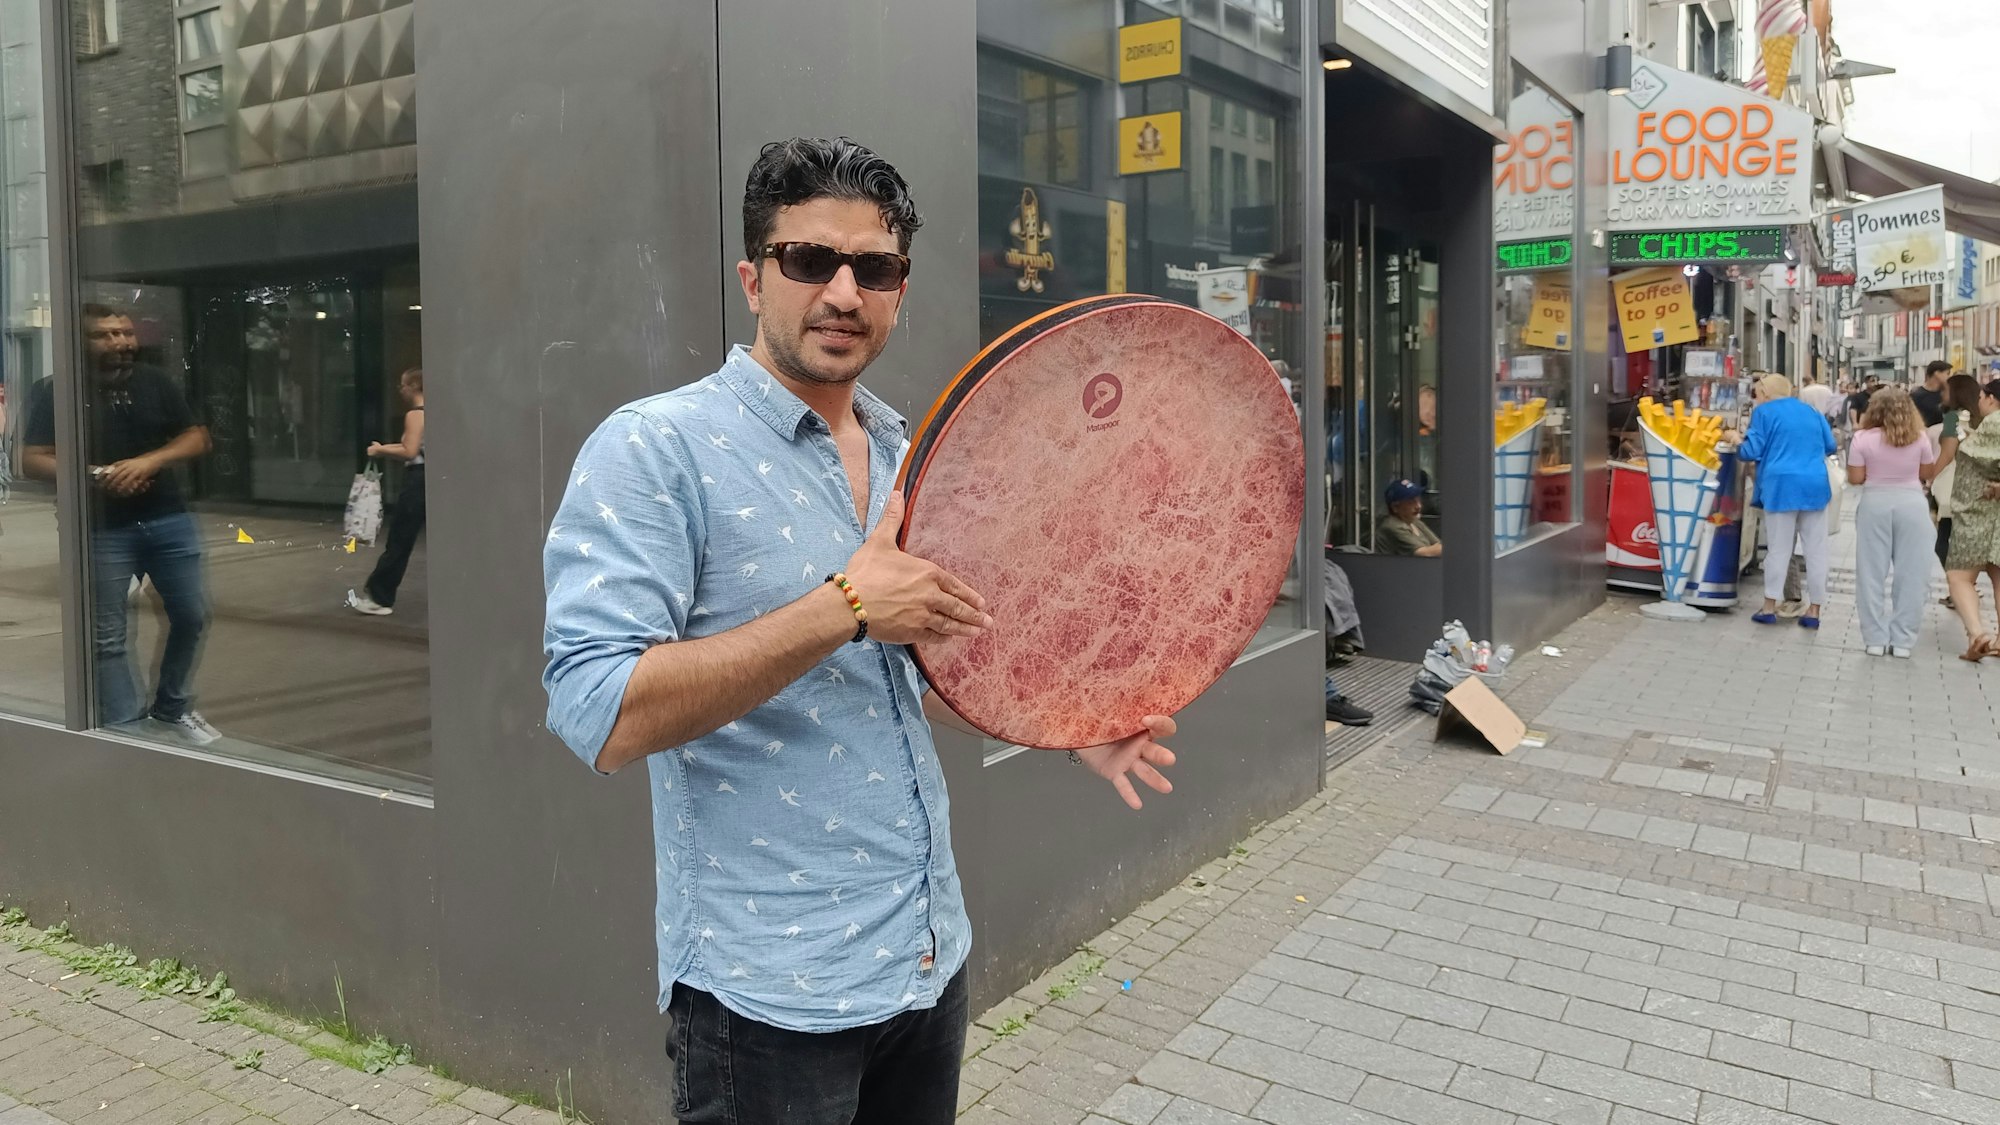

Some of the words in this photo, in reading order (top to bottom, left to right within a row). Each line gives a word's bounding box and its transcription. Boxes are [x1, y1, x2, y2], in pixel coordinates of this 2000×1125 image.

[1637, 103, 1774, 147] FOOD
[1613, 138, 1798, 184] LOUNGE
[1618, 184, 1692, 204] SOFTEIS
[1704, 180, 1789, 198] POMMES
[1607, 201, 1735, 222] CURRYWURST
[1745, 199, 1801, 216] PIZZA
[1857, 208, 1942, 235] Pommes
[1901, 250, 1915, 264] €
[1901, 270, 1945, 287] Frites
[1622, 282, 1683, 305] Coffee
[1626, 308, 1646, 321] to
[1655, 302, 1680, 319] go
